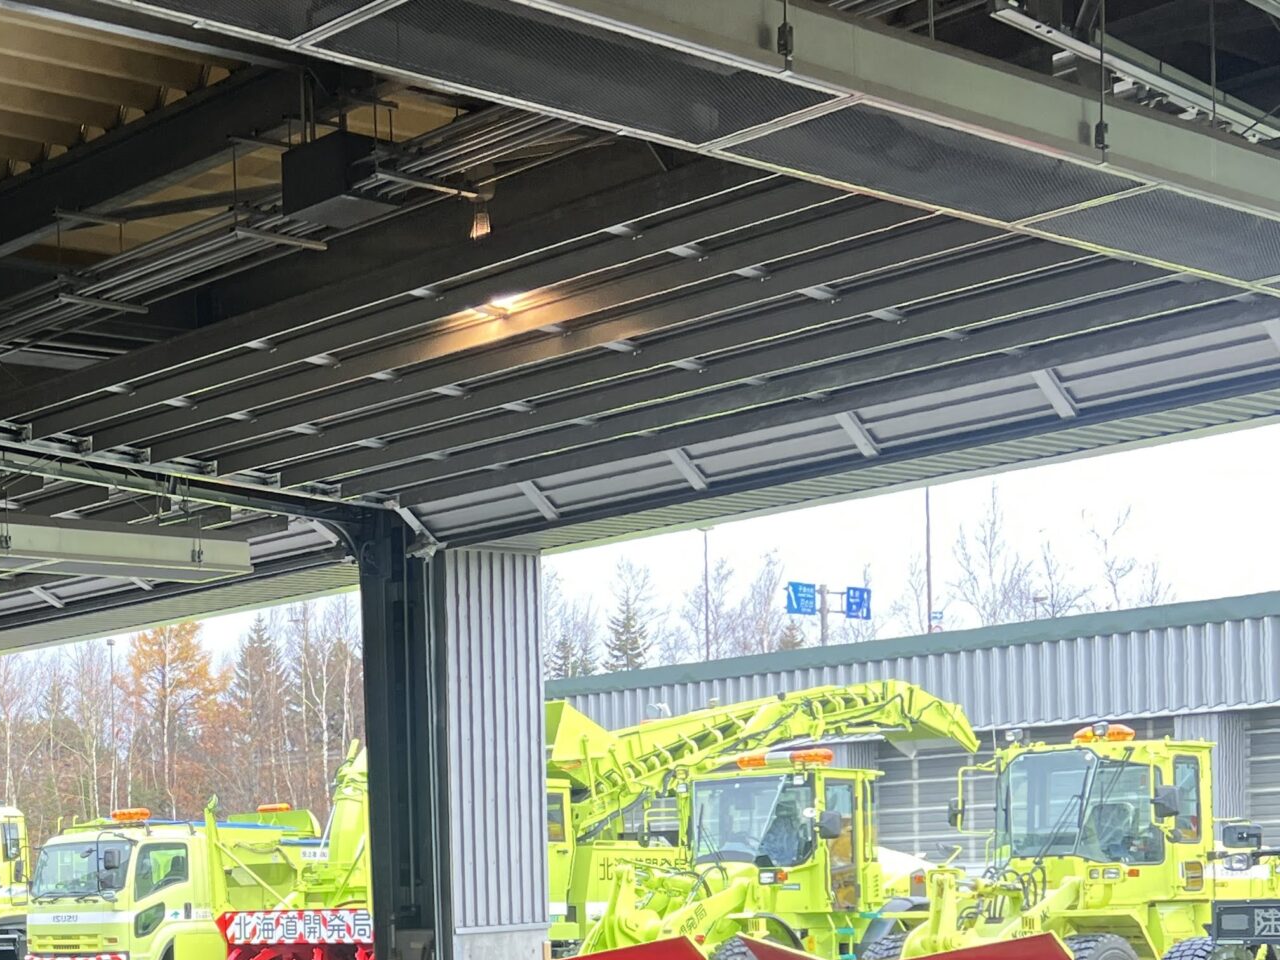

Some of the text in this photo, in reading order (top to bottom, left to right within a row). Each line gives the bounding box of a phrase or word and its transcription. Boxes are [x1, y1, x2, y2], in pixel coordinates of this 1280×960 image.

[52, 914, 78, 923] ISUZU
[234, 913, 371, 941] 北海道開発局
